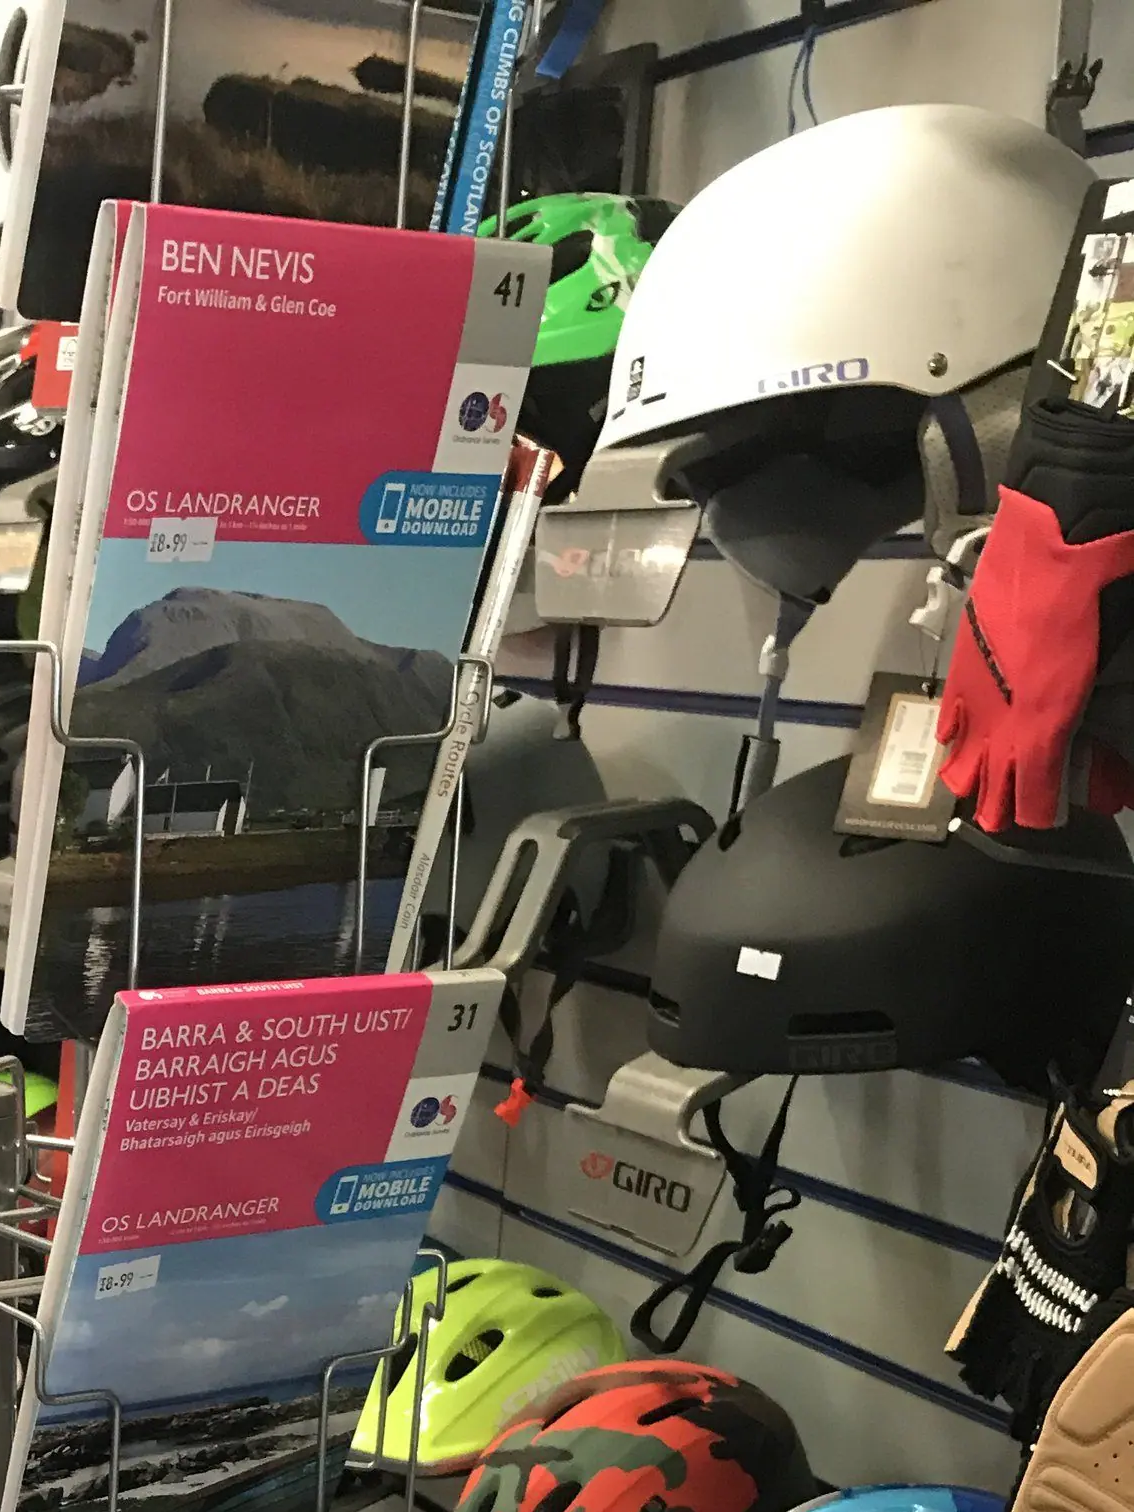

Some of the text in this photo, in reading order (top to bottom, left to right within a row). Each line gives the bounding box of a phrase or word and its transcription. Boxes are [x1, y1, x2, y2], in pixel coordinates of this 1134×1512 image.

[484, 28, 518, 136] CLIMBS OF
[161, 240, 315, 283] BEN NEVIS
[158, 286, 337, 317] Fort William & Glen Coe
[494, 271, 525, 308] 41
[126, 490, 321, 518] OS LANDRANGER
[411, 484, 487, 498] NOW INCLUDES
[404, 497, 484, 521] MOBILE
[401, 520, 478, 536] DOWNLOAD
[436, 690, 480, 798] Cycle Routes
[197, 987, 232, 997] BARRA
[243, 983, 279, 993] SOUTH
[141, 1008, 413, 1050] BARRA & SOUTH UIST/
[447, 1003, 478, 1033] 31
[135, 1044, 339, 1081] BARRAIGH AGUS
[130, 1073, 321, 1111] UIBHIST A DEAS
[120, 1119, 311, 1152] Bhatarsaigh agus Eirisgeigh
[125, 1107, 259, 1133] Vatersay & Eriskay/
[353, 1193, 426, 1212] DOWNLOAD
[357, 1175, 433, 1201] MOBILE
[612, 1160, 692, 1213] GIRO
[101, 1214, 130, 1233] OS
[136, 1197, 279, 1230] LANDRANGER
